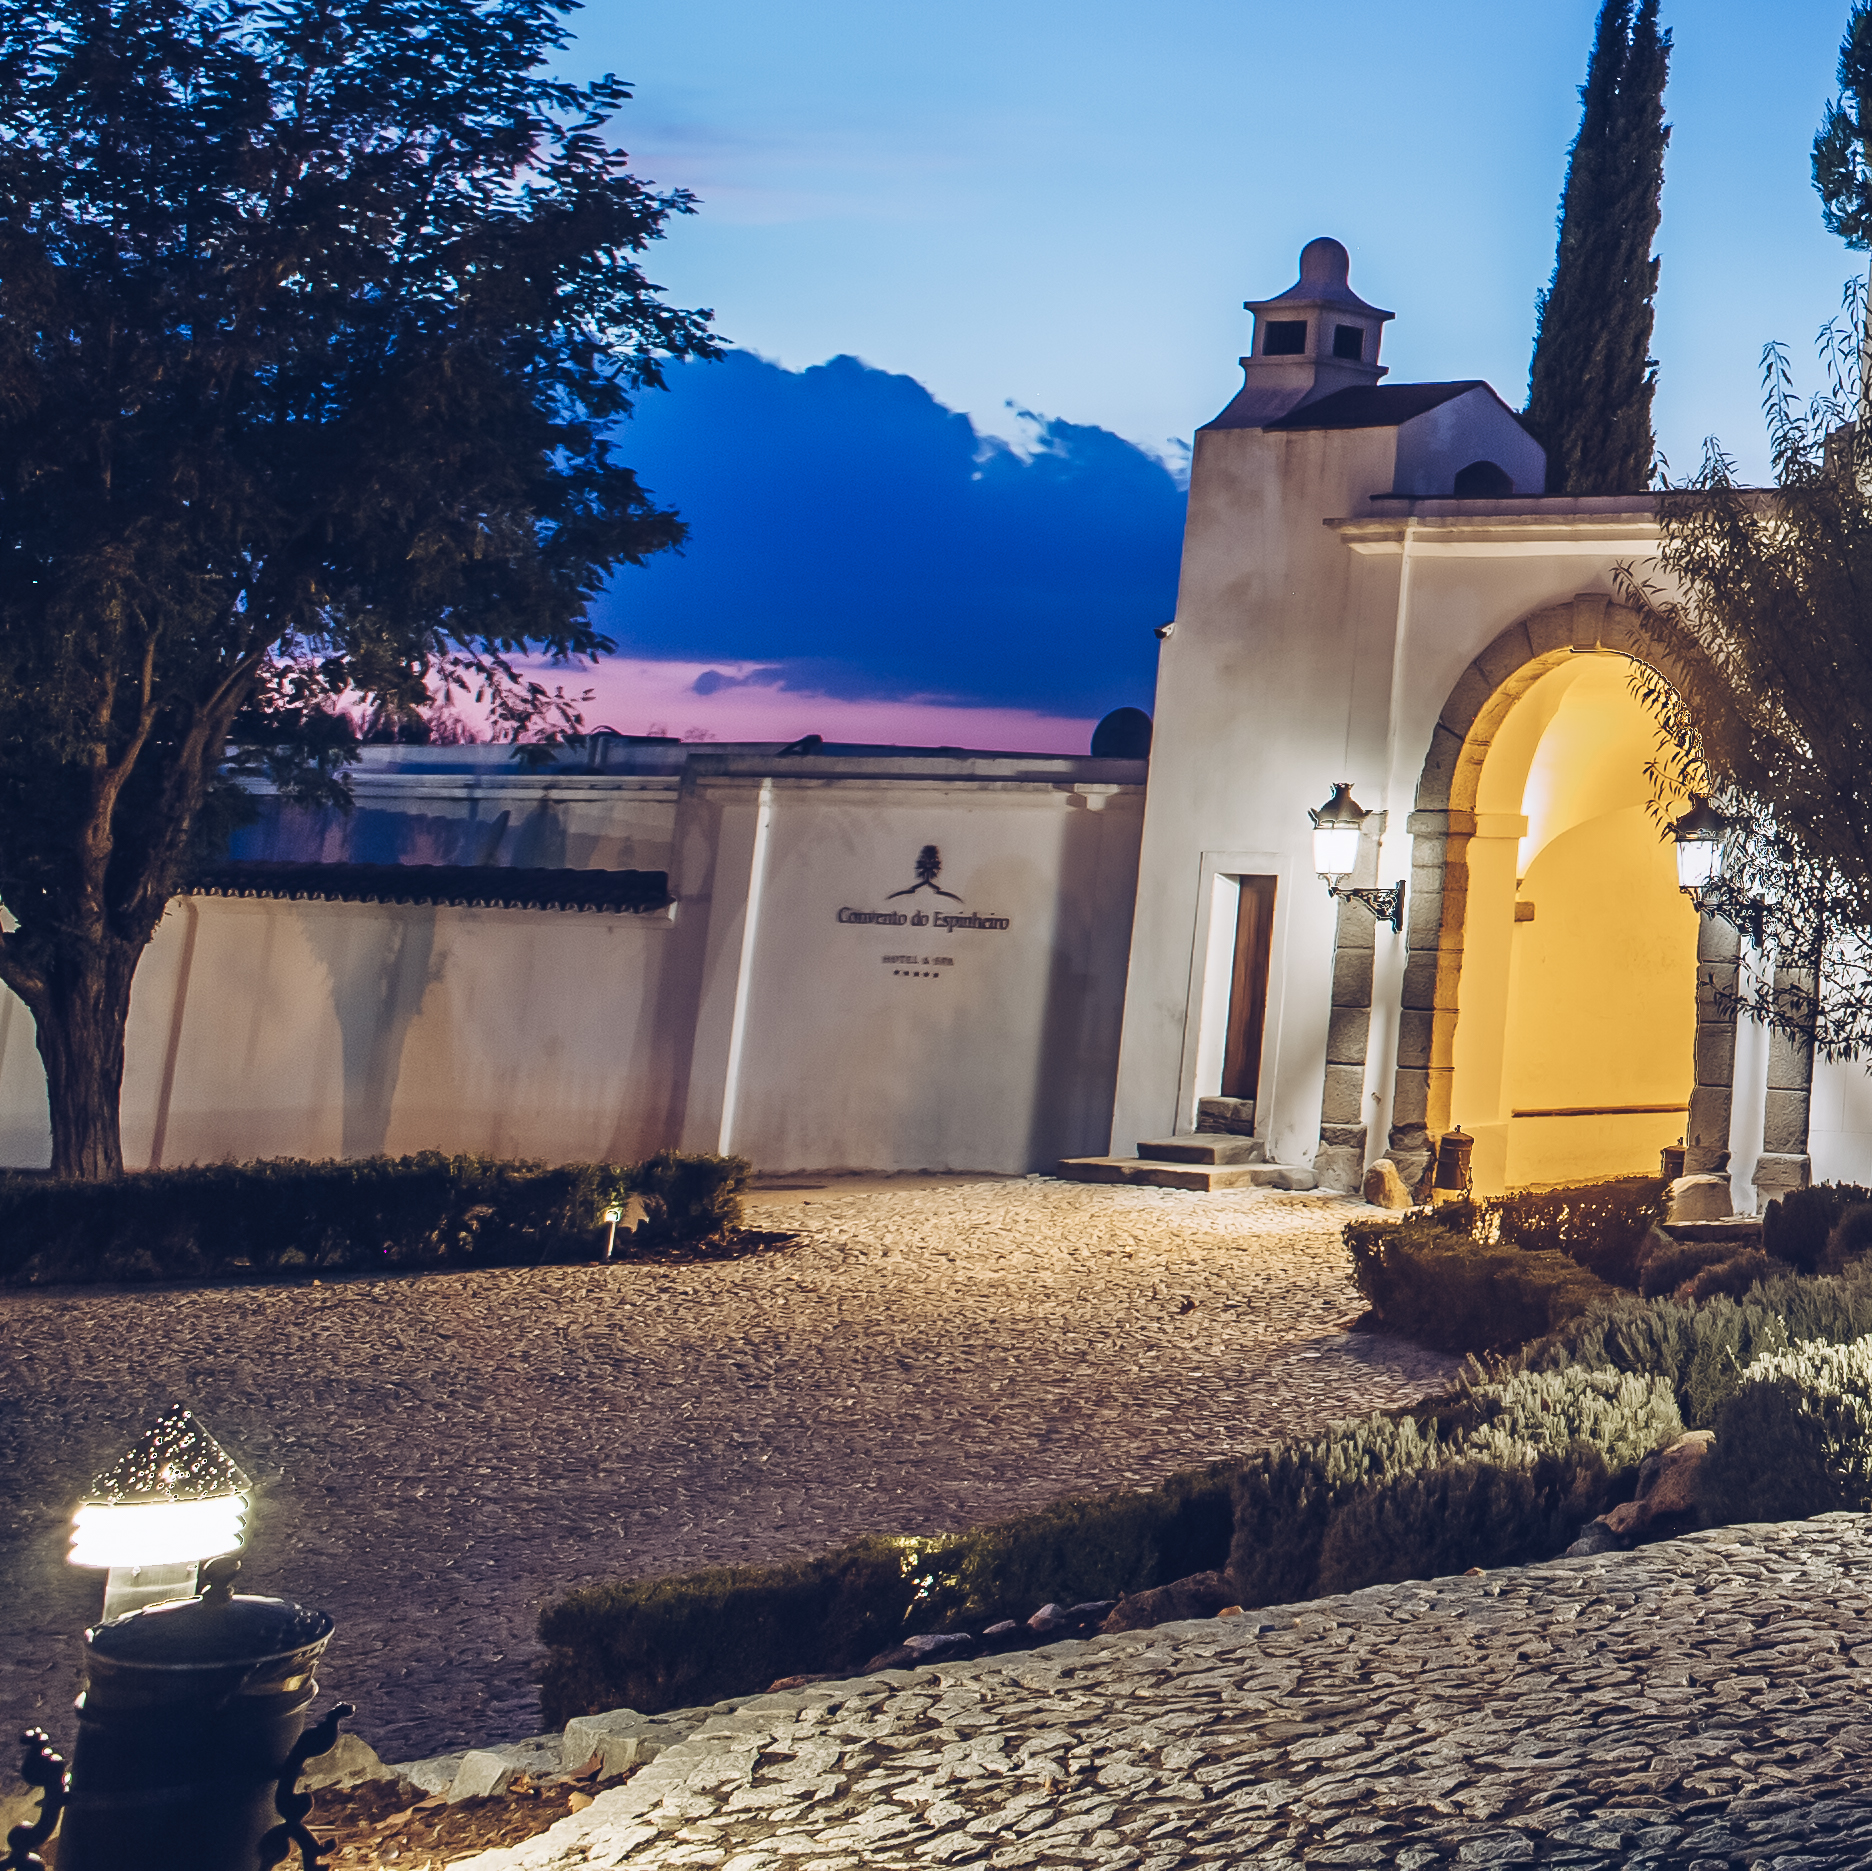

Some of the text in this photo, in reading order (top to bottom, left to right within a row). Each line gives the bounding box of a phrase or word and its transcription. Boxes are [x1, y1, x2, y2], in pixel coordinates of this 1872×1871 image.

[837, 906, 1010, 933] Convento do Espinheiro
[881, 955, 918, 964] HOTEL
